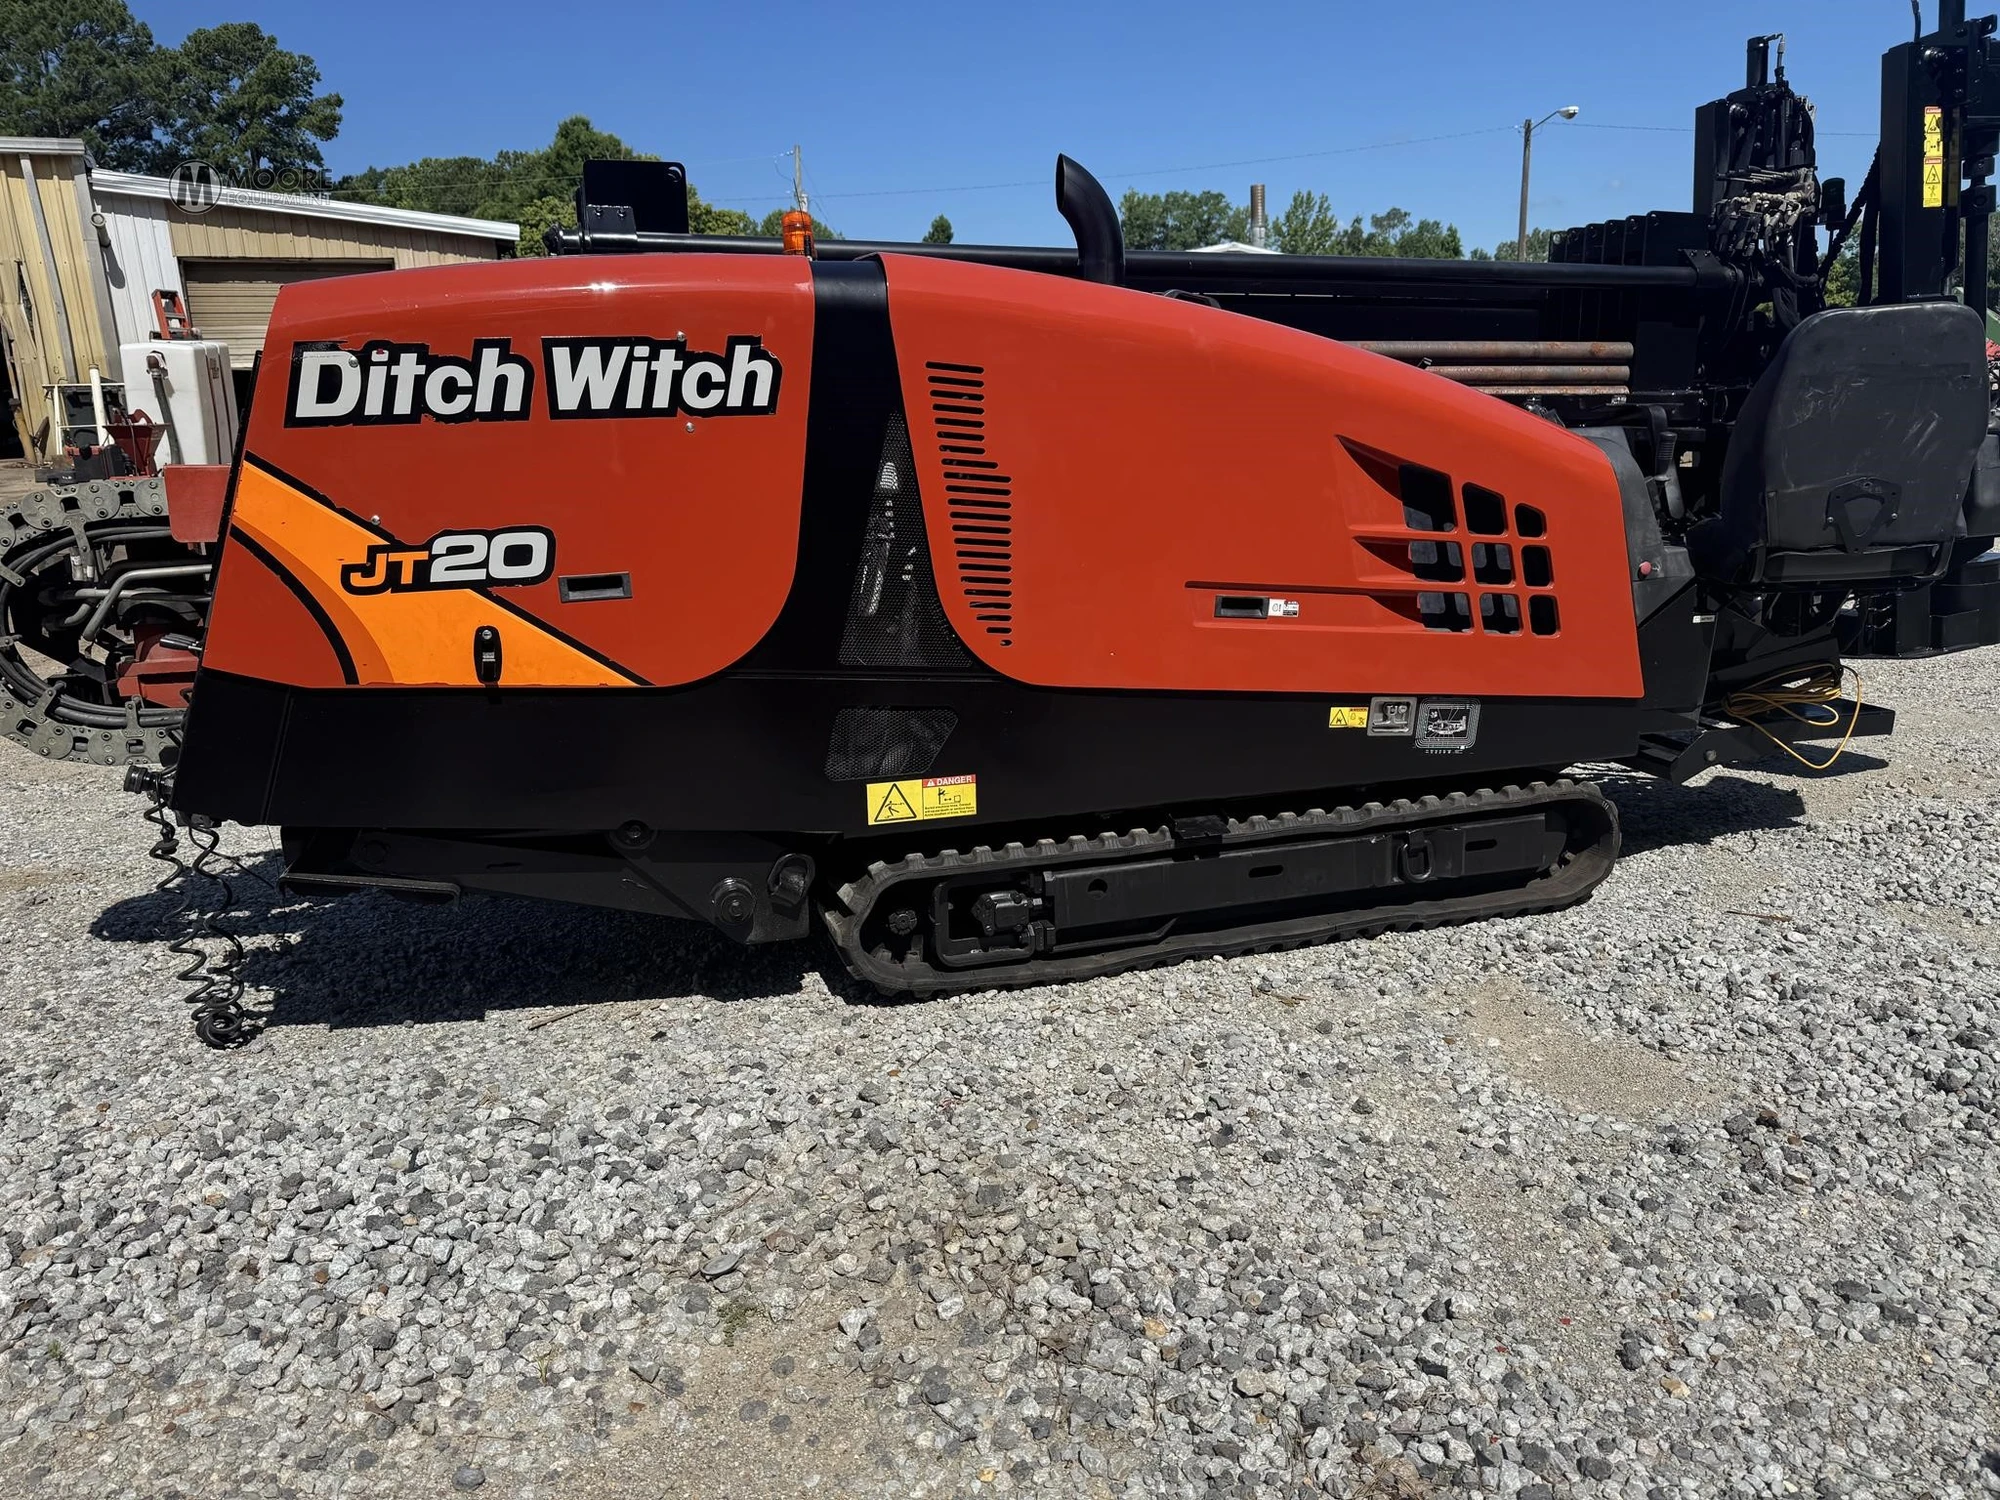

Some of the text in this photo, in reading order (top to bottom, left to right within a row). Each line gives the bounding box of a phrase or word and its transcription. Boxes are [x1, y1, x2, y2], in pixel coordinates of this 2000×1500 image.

[295, 344, 774, 418] Ditch Witch
[350, 531, 549, 587] JT20
[936, 776, 973, 786] DANGER
